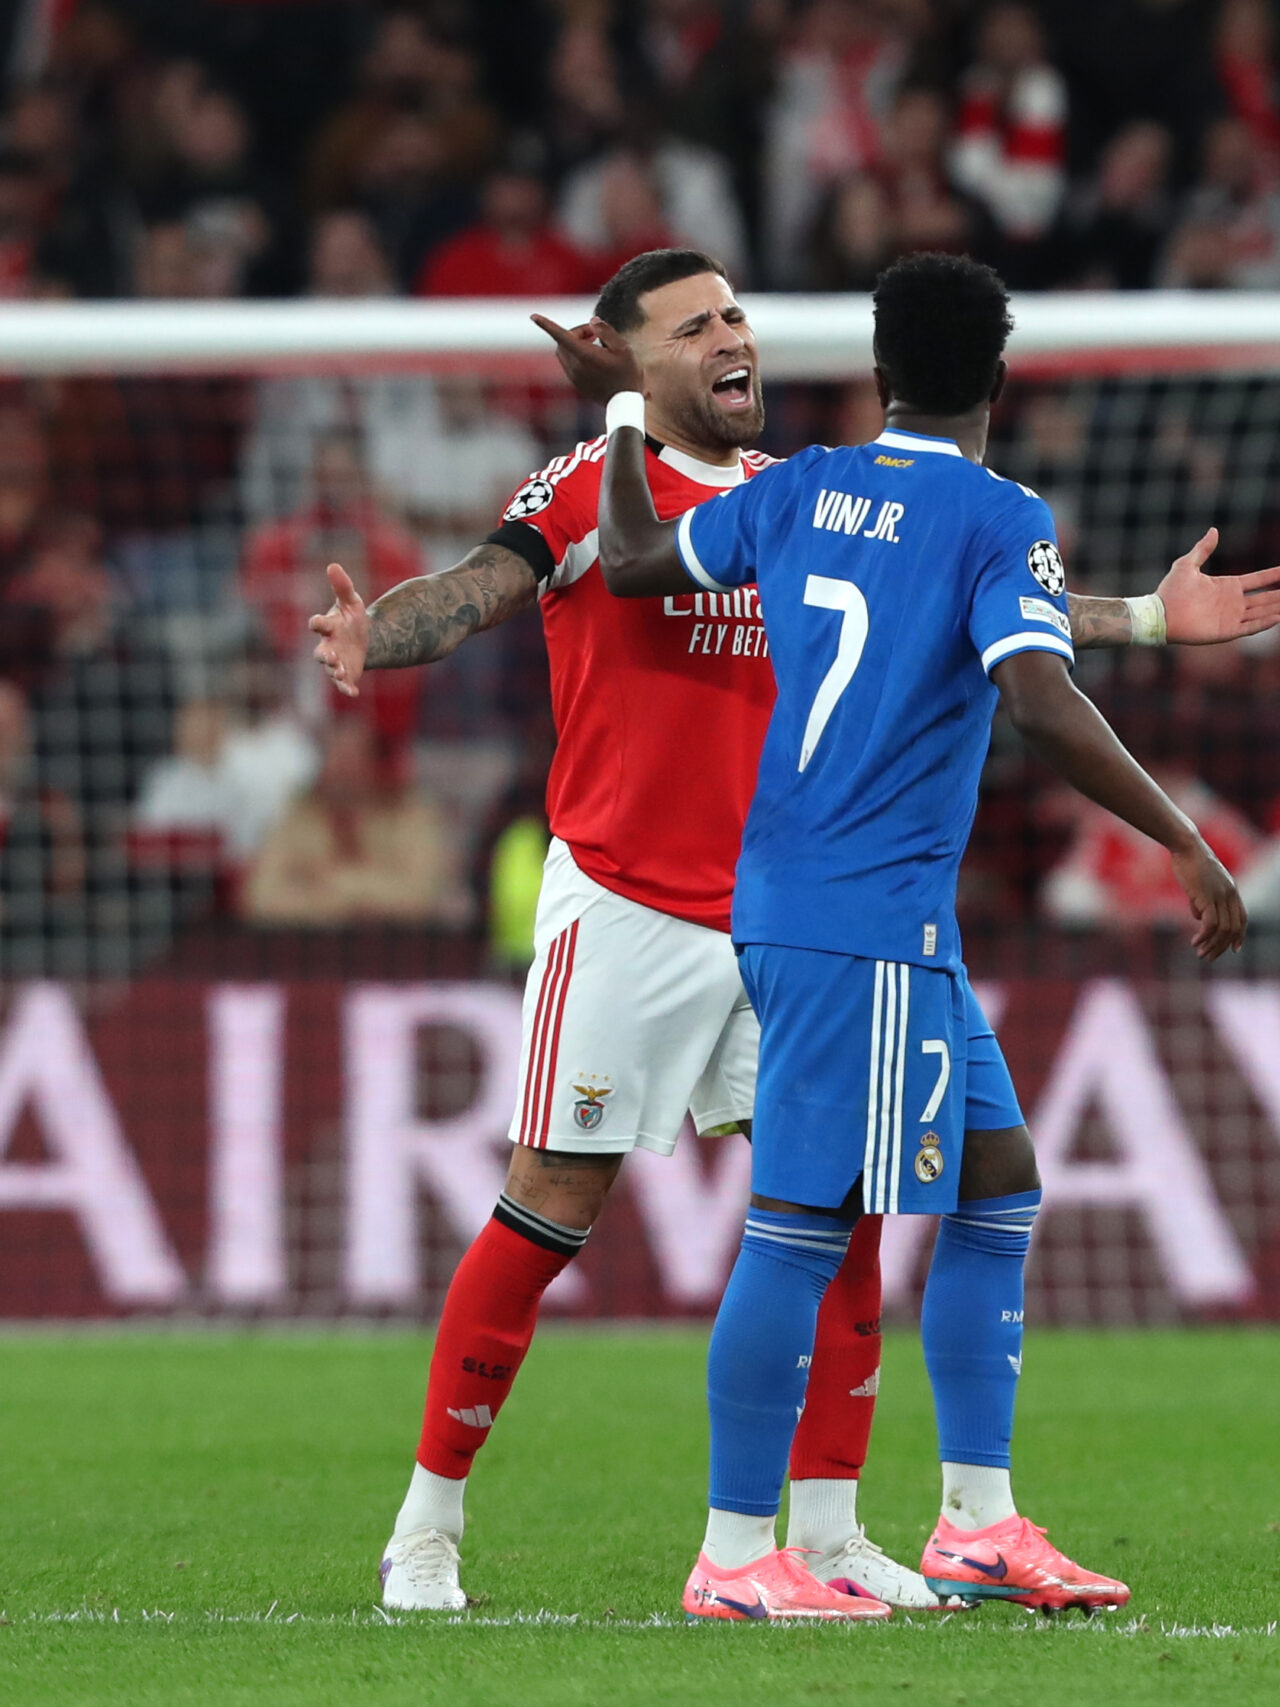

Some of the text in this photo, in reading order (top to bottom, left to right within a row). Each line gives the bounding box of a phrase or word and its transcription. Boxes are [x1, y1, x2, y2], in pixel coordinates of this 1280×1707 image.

[874, 455, 915, 468] RMCF
[813, 489, 905, 544] VINI JR.
[688, 623, 728, 655] FLY
[798, 574, 869, 774] 7
[919, 1040, 951, 1123] 7
